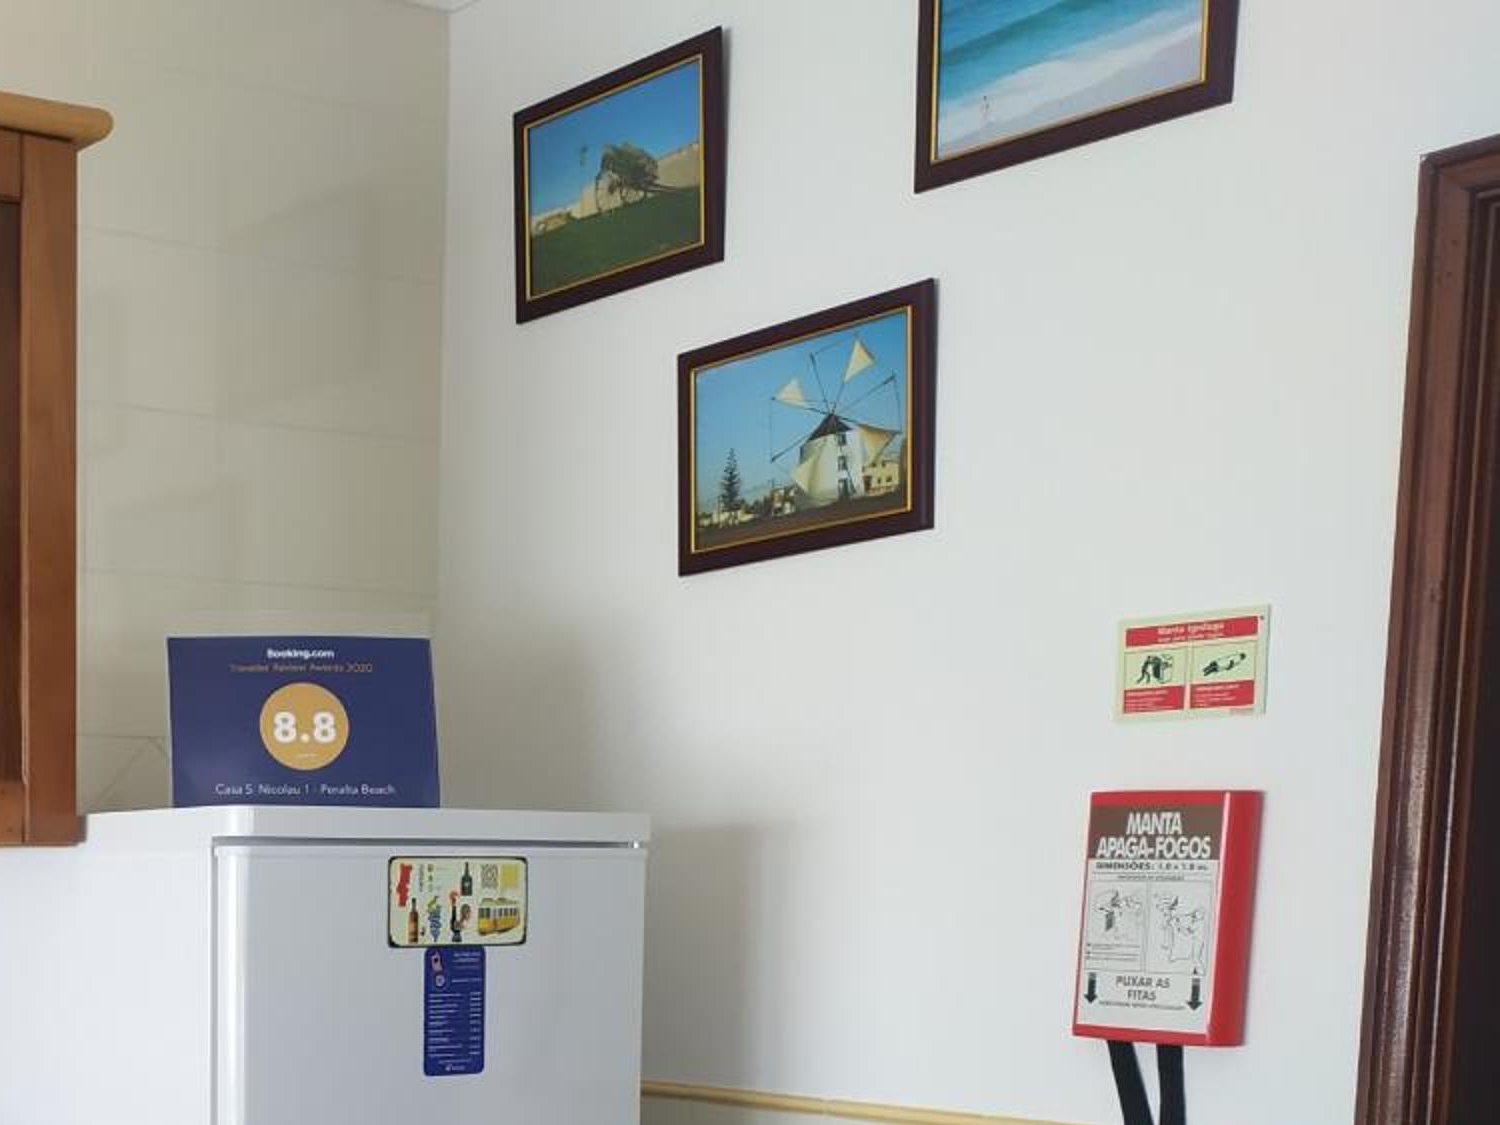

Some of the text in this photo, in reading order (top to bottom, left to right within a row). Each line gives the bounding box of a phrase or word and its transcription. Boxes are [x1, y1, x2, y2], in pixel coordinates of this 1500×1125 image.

[267, 648, 335, 660] Booking.com
[309, 663, 344, 673] Awards
[346, 662, 373, 673] 2020
[273, 711, 337, 744] 8.8
[215, 784, 243, 795] Casa
[258, 784, 301, 795] Nicolau
[361, 785, 396, 796] Beach
[1126, 811, 1183, 835] MANTA
[1096, 836, 1211, 859] APAGA-FOGOS
[1116, 976, 1171, 989] PUXAR AS
[1127, 990, 1157, 1001] FITAS
